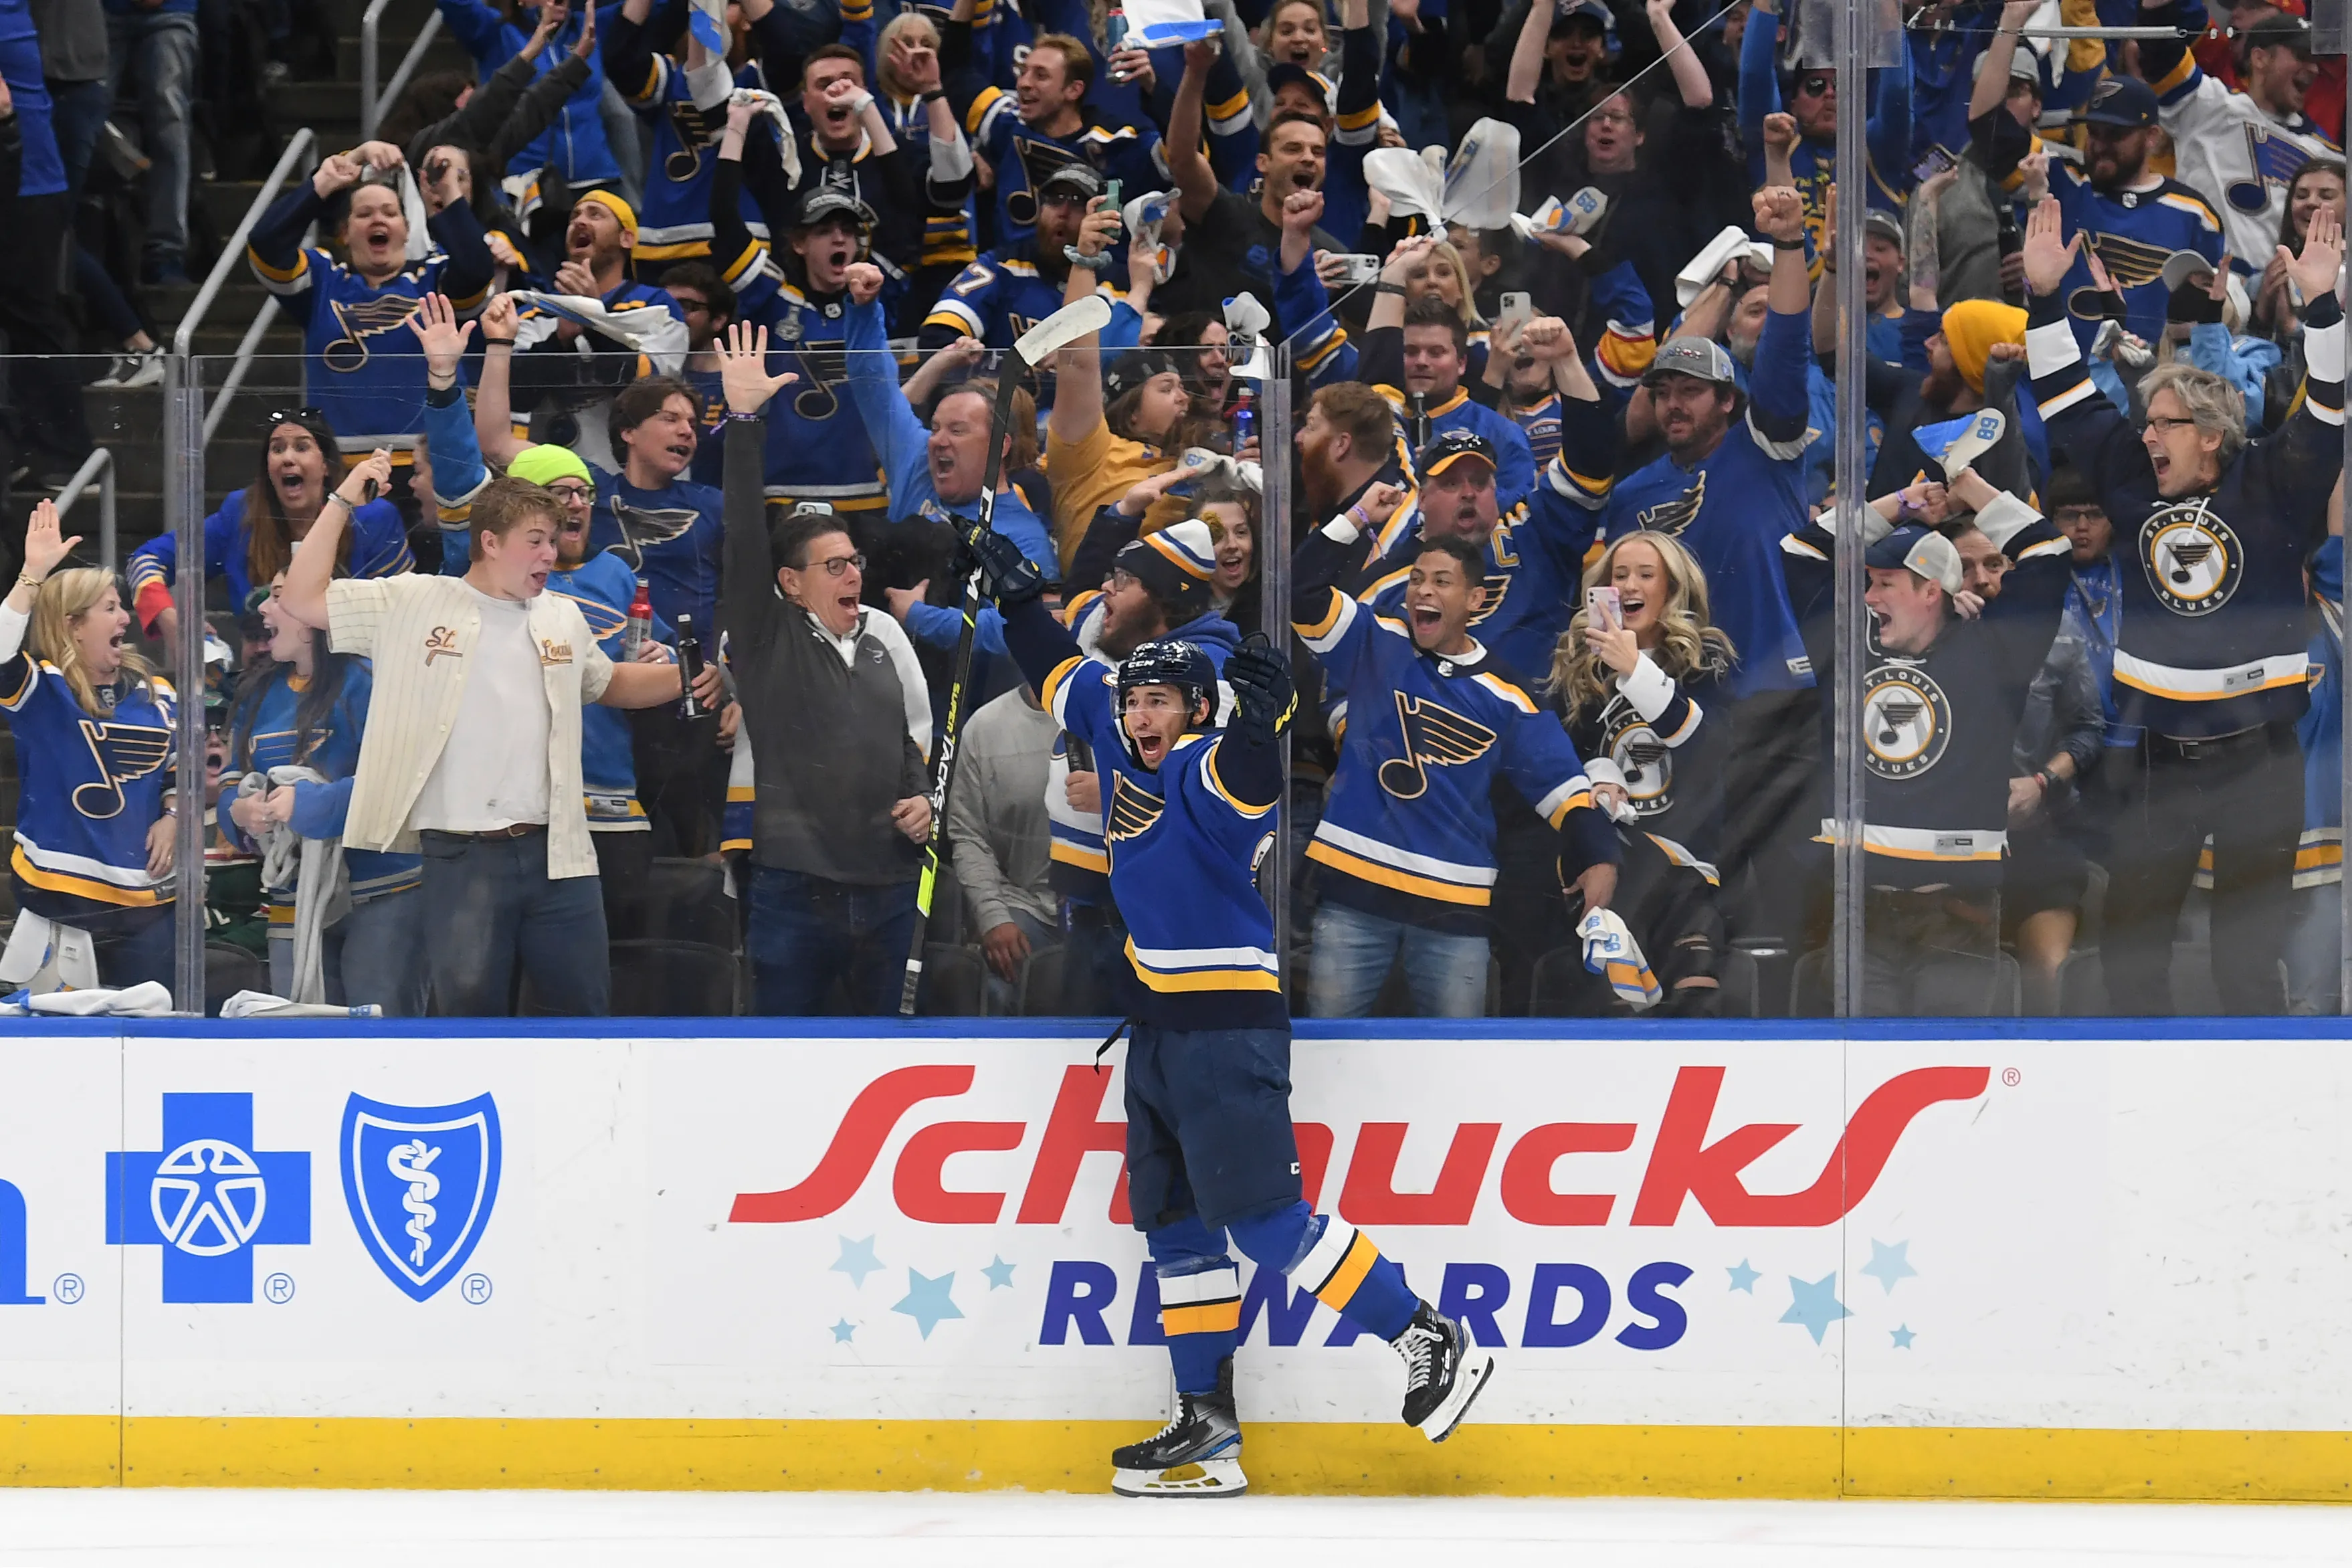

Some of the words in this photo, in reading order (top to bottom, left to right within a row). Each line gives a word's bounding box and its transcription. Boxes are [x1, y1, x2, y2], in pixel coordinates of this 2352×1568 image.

[2170, 512, 2230, 542] LOUIS
[2160, 589, 2224, 611] BLUES
[1127, 659, 1156, 669] CCM
[1884, 671, 1940, 702] LOUIS
[946, 682, 961, 734] SUPER
[933, 734, 957, 813] TACKS
[1866, 753, 1929, 774] BLUES
[728, 1065, 1990, 1227] Schucks
